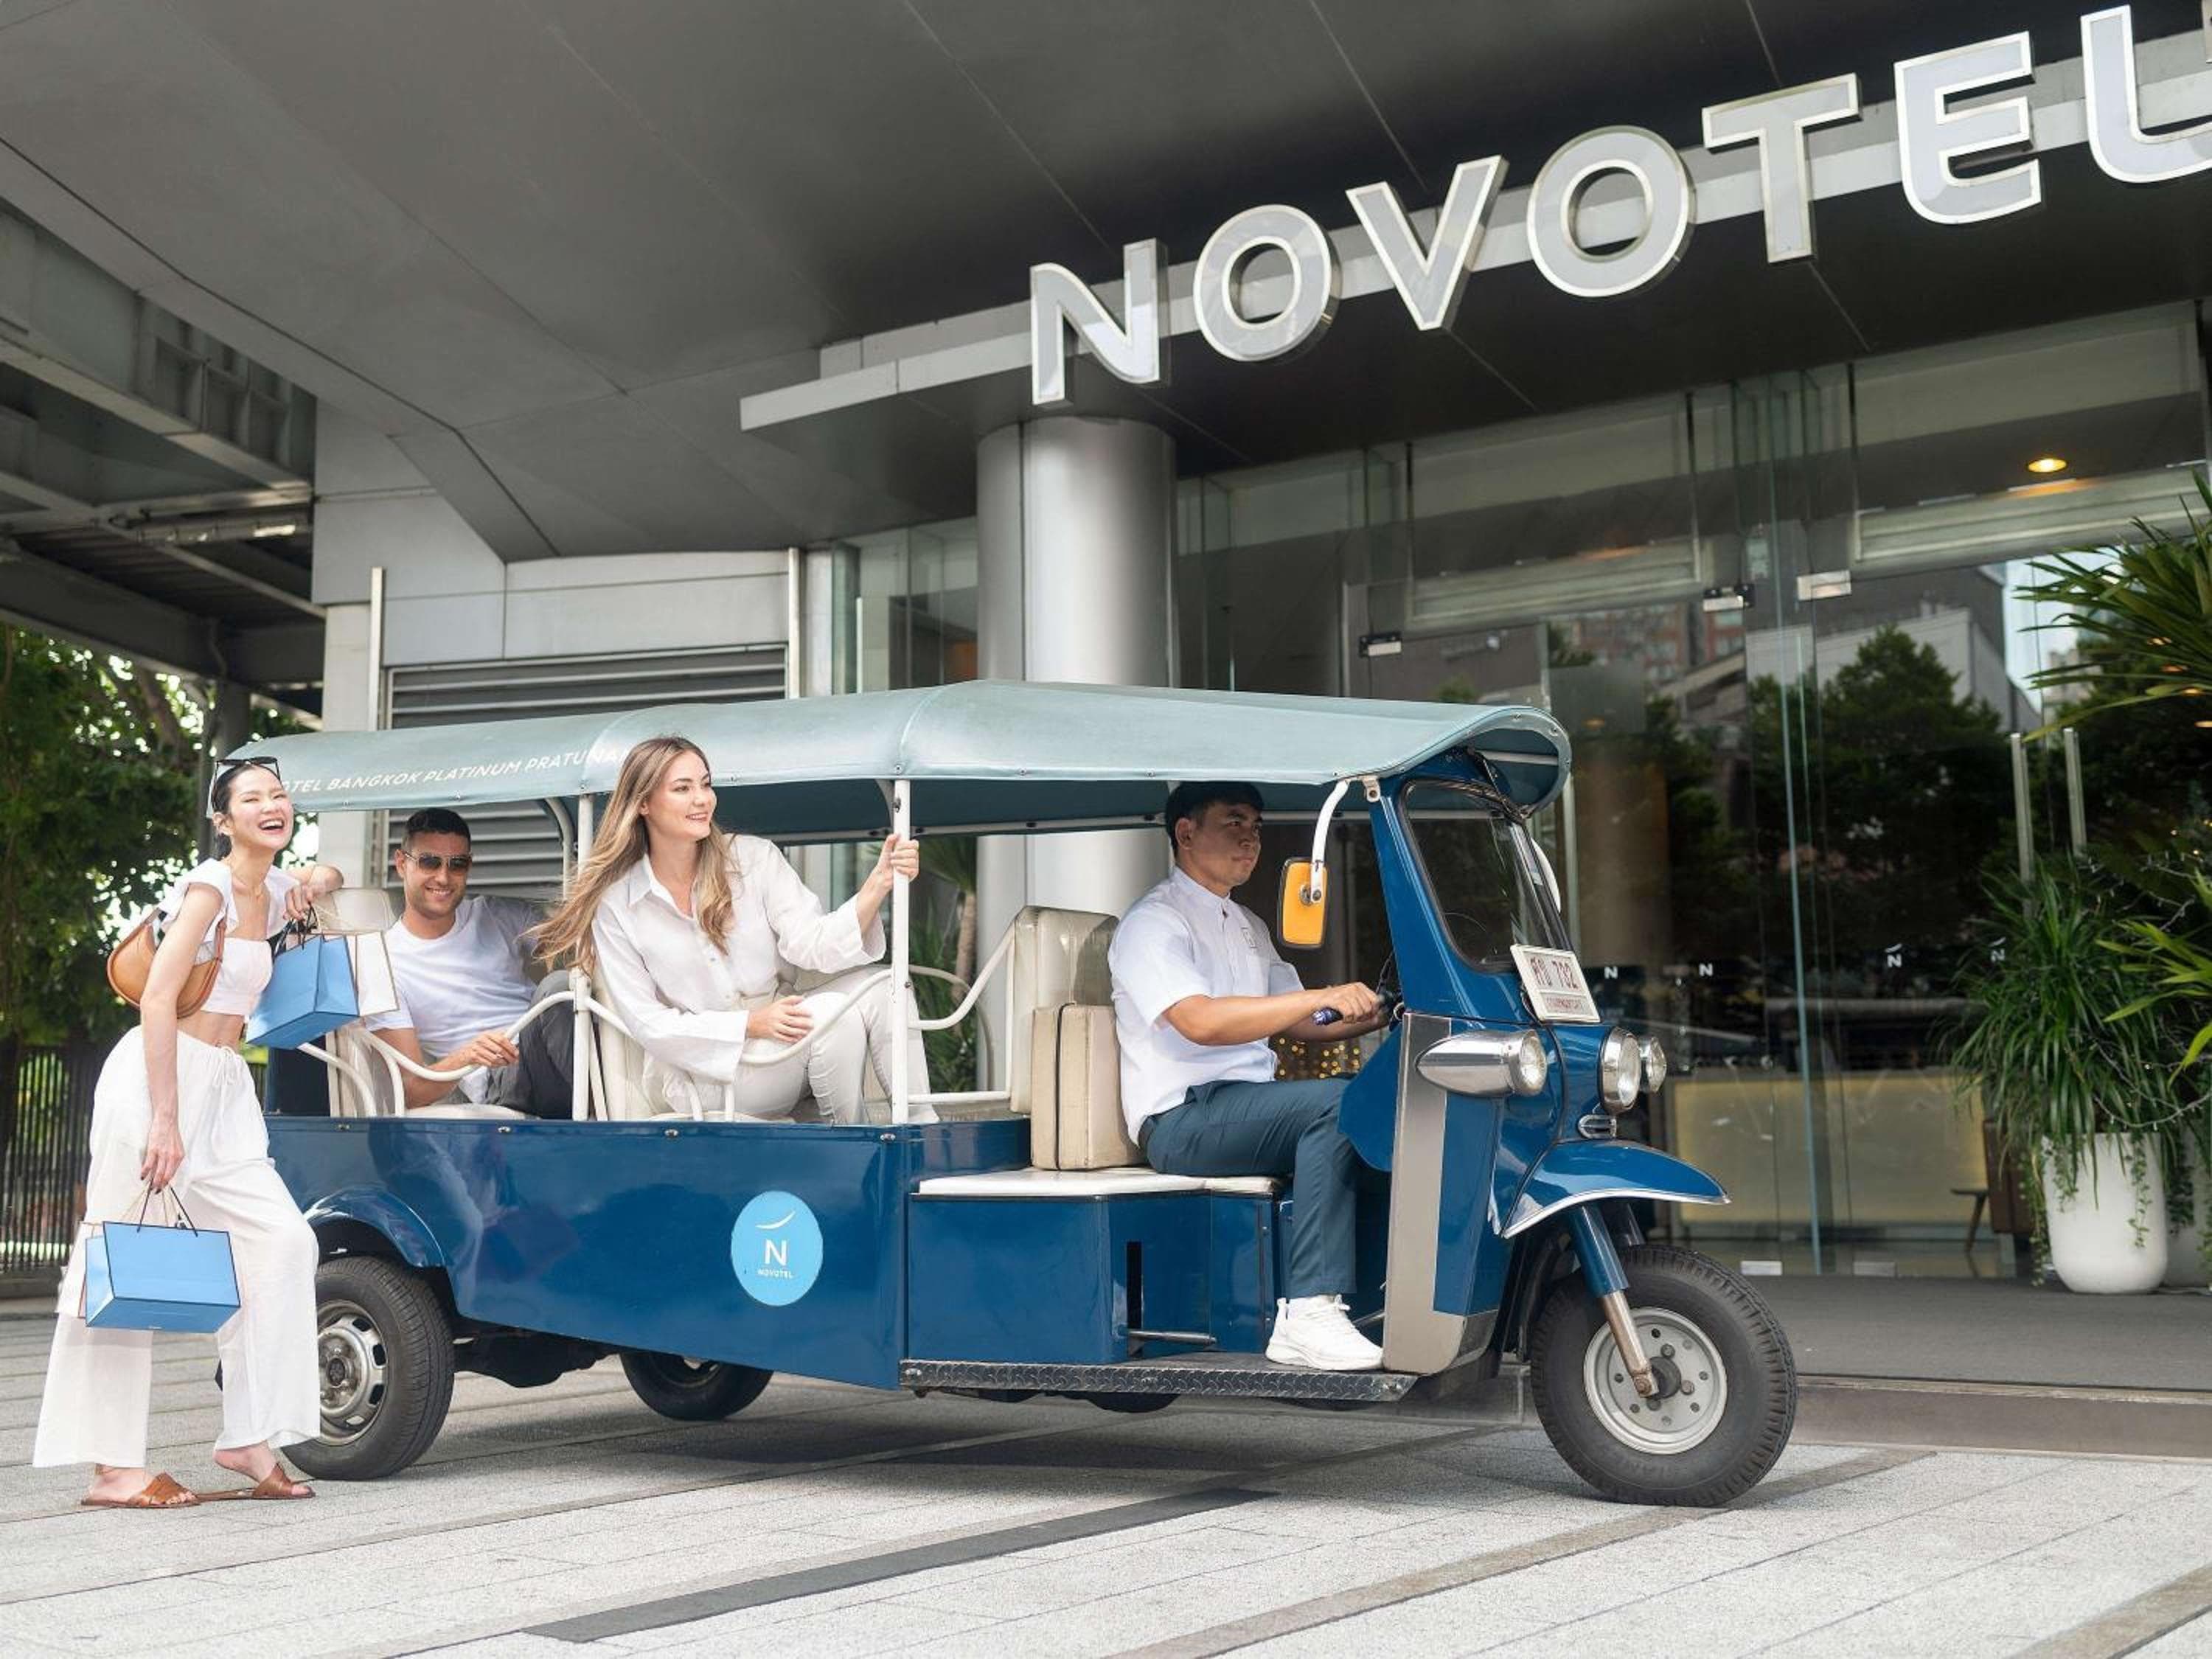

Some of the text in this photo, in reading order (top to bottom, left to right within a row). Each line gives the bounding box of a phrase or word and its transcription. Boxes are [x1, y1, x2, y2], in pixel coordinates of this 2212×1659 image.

[1030, 5, 2212, 406] NOVOTEL
[327, 772, 420, 790] BANGKOK
[422, 760, 522, 782] PLATINUM
[1886, 953, 1902, 967] N
[1604, 965, 1618, 980] N
[1698, 963, 1714, 977] N
[765, 1239, 787, 1266] N
[757, 1267, 794, 1279] NOVOTEL
